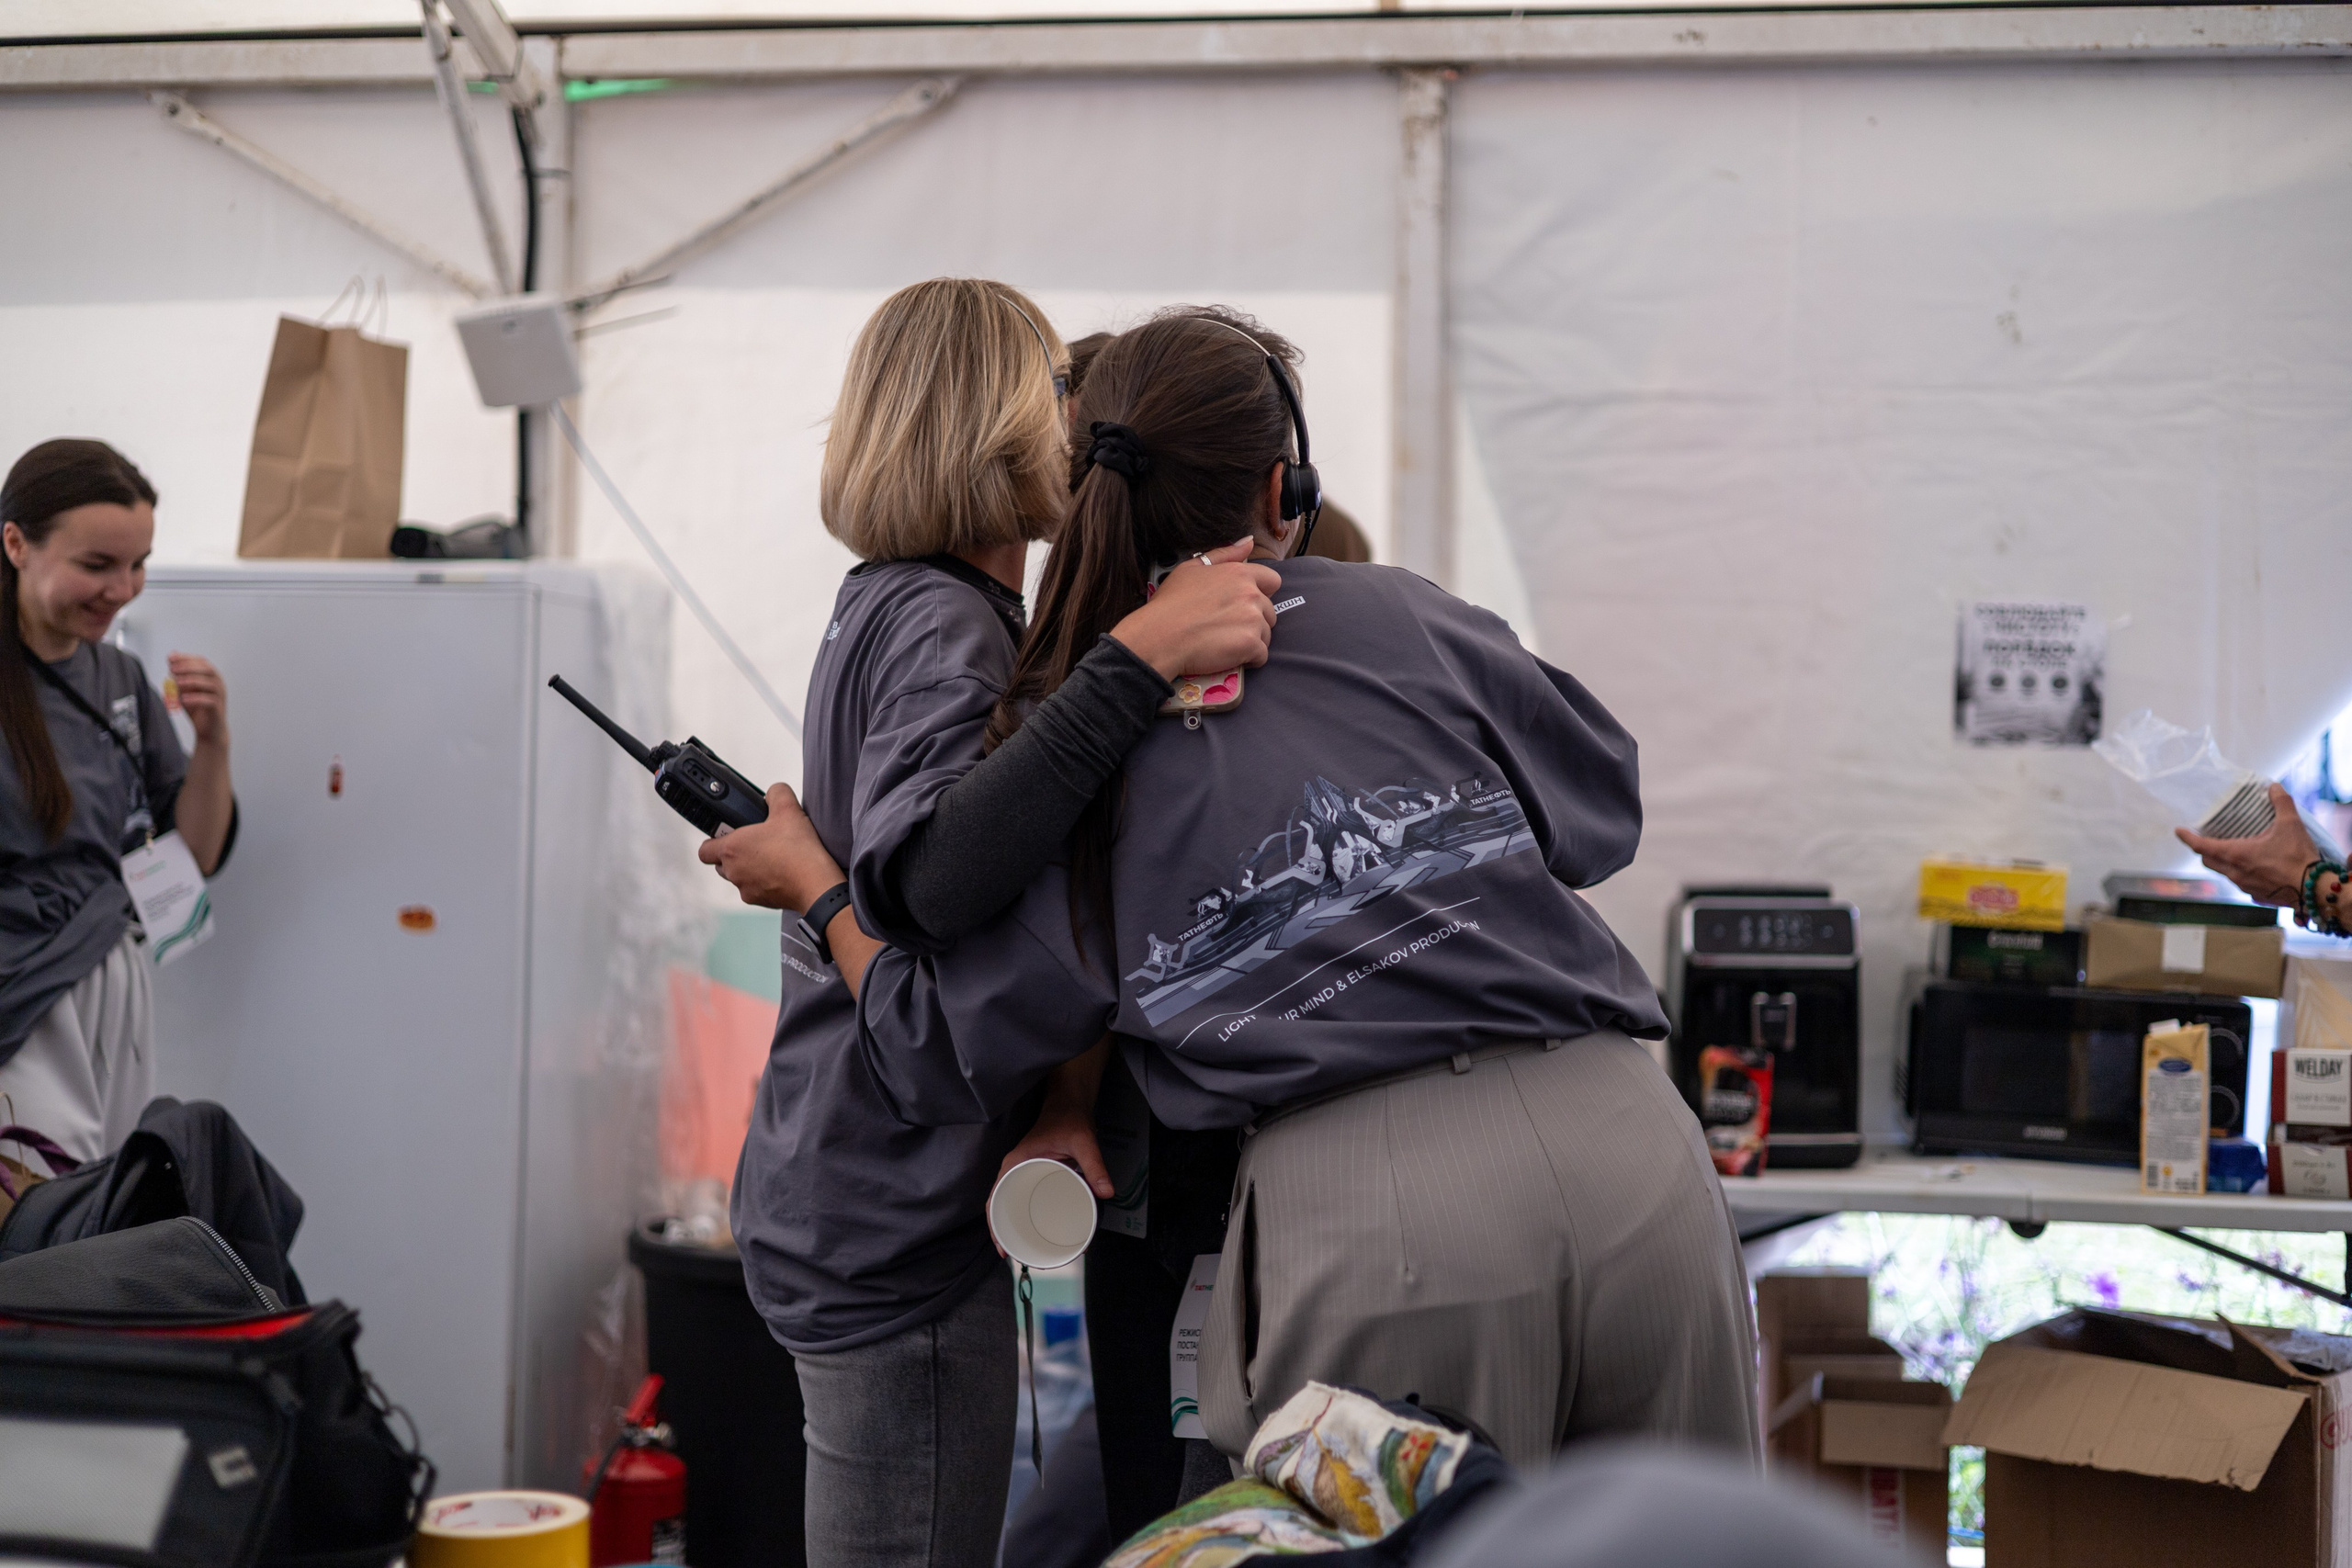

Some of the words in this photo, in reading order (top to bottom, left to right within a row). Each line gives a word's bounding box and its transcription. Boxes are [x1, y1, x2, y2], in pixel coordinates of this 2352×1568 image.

[1471, 789, 1511, 806] ТАТНЕФТЬ
[1178, 913, 1224, 942] ТАТНЕФТЬ
[1299, 987, 1335, 1015] MIND
[1336, 980, 1348, 991] &
[1347, 947, 1408, 984] ELSAKOV
[2295, 1057, 2343, 1077] WELDAY
[1179, 1328, 1202, 1337] РЕЖИС
